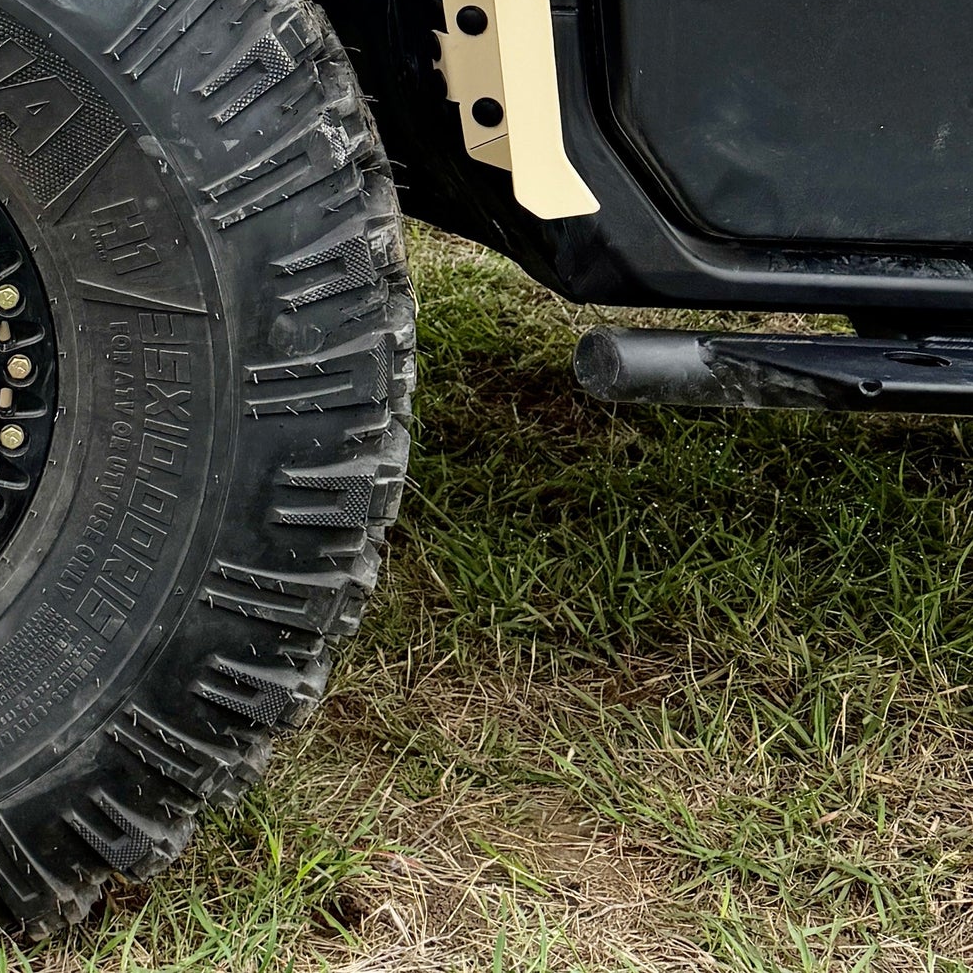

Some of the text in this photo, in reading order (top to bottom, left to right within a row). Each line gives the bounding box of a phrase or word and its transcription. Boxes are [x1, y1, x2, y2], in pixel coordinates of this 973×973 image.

[107, 419, 134, 452] OR
[80, 500, 116, 545] USE
[50, 541, 98, 601] ONLY
